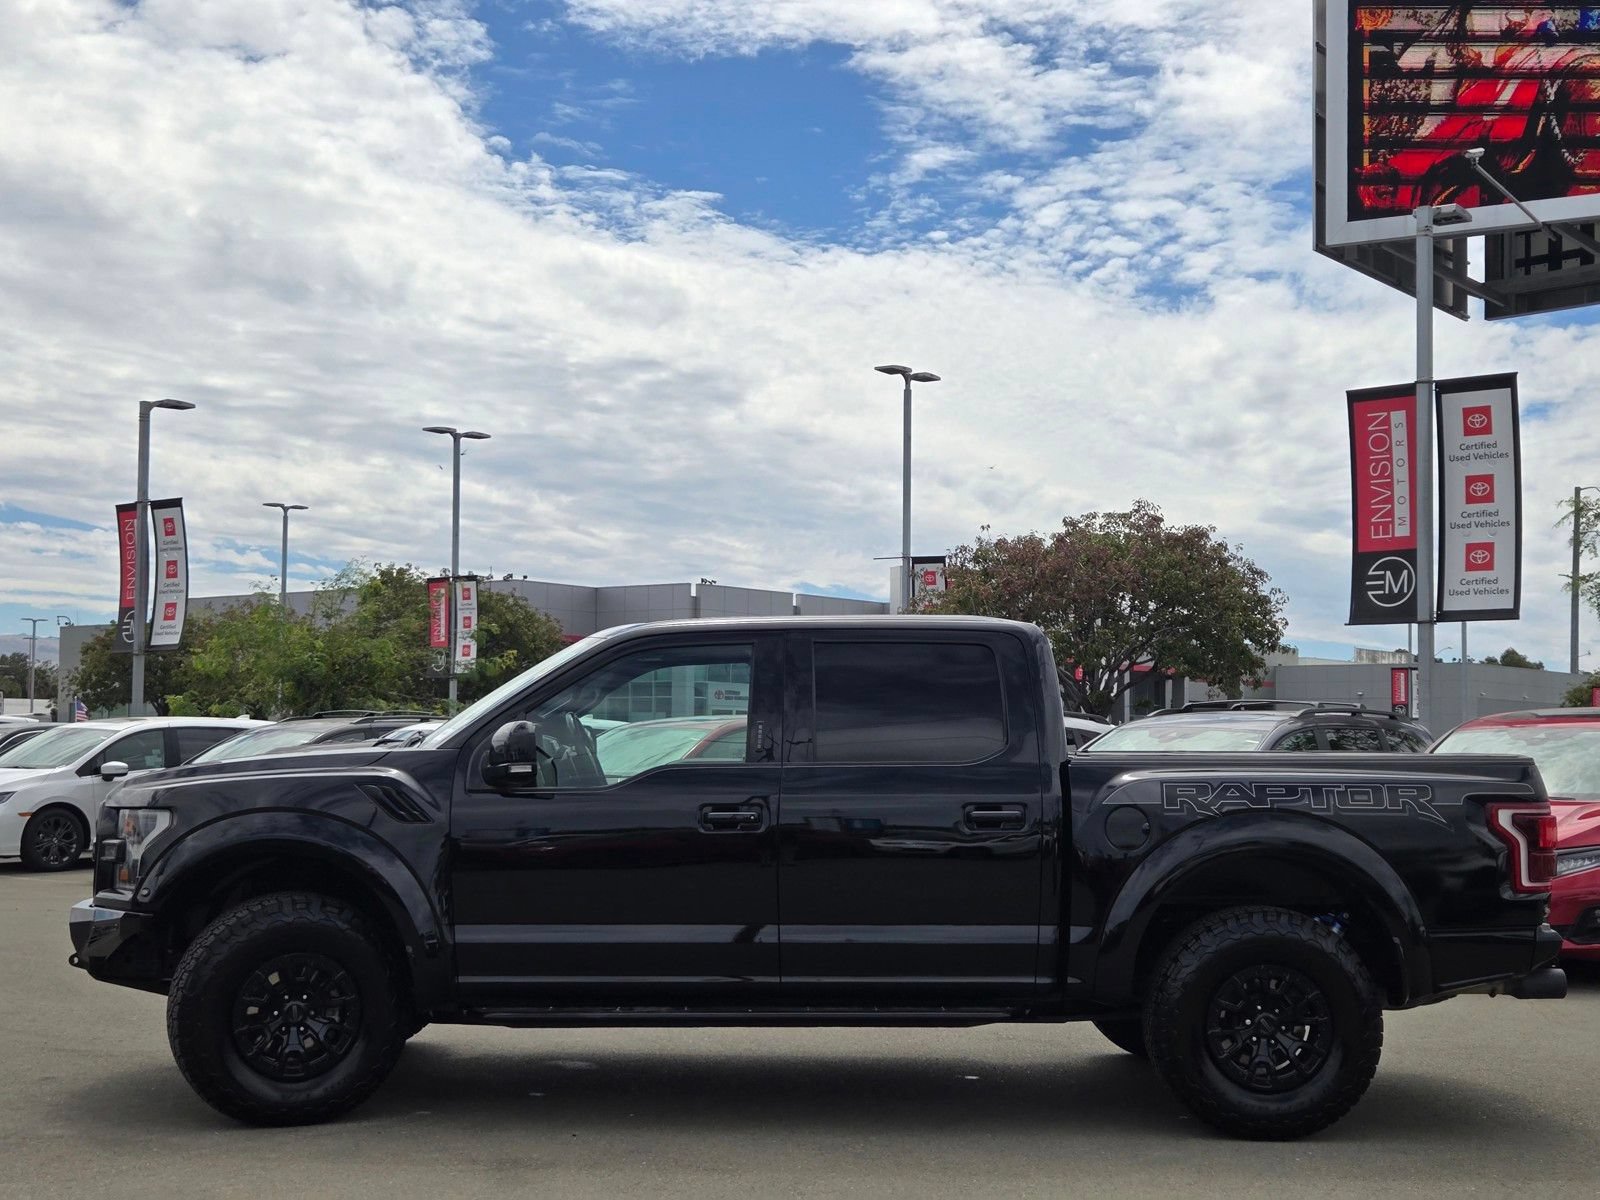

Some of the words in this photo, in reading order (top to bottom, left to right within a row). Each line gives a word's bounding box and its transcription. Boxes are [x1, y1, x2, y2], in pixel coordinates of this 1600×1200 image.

[1459, 441, 1498, 451] Certified
[1449, 453, 1471, 462] Used
[1472, 451, 1509, 460] Vehicles
[1367, 411, 1392, 539] ENVISION
[1395, 421, 1408, 527] MOTORS
[1461, 509, 1499, 519] Certified
[1450, 522, 1472, 530] Used
[1473, 519, 1511, 529] Vehicles
[1460, 576, 1499, 586] Certified
[1449, 588, 1471, 596] Used
[1472, 586, 1509, 596] Vehicles
[1163, 783, 1448, 824] RAPTOR
